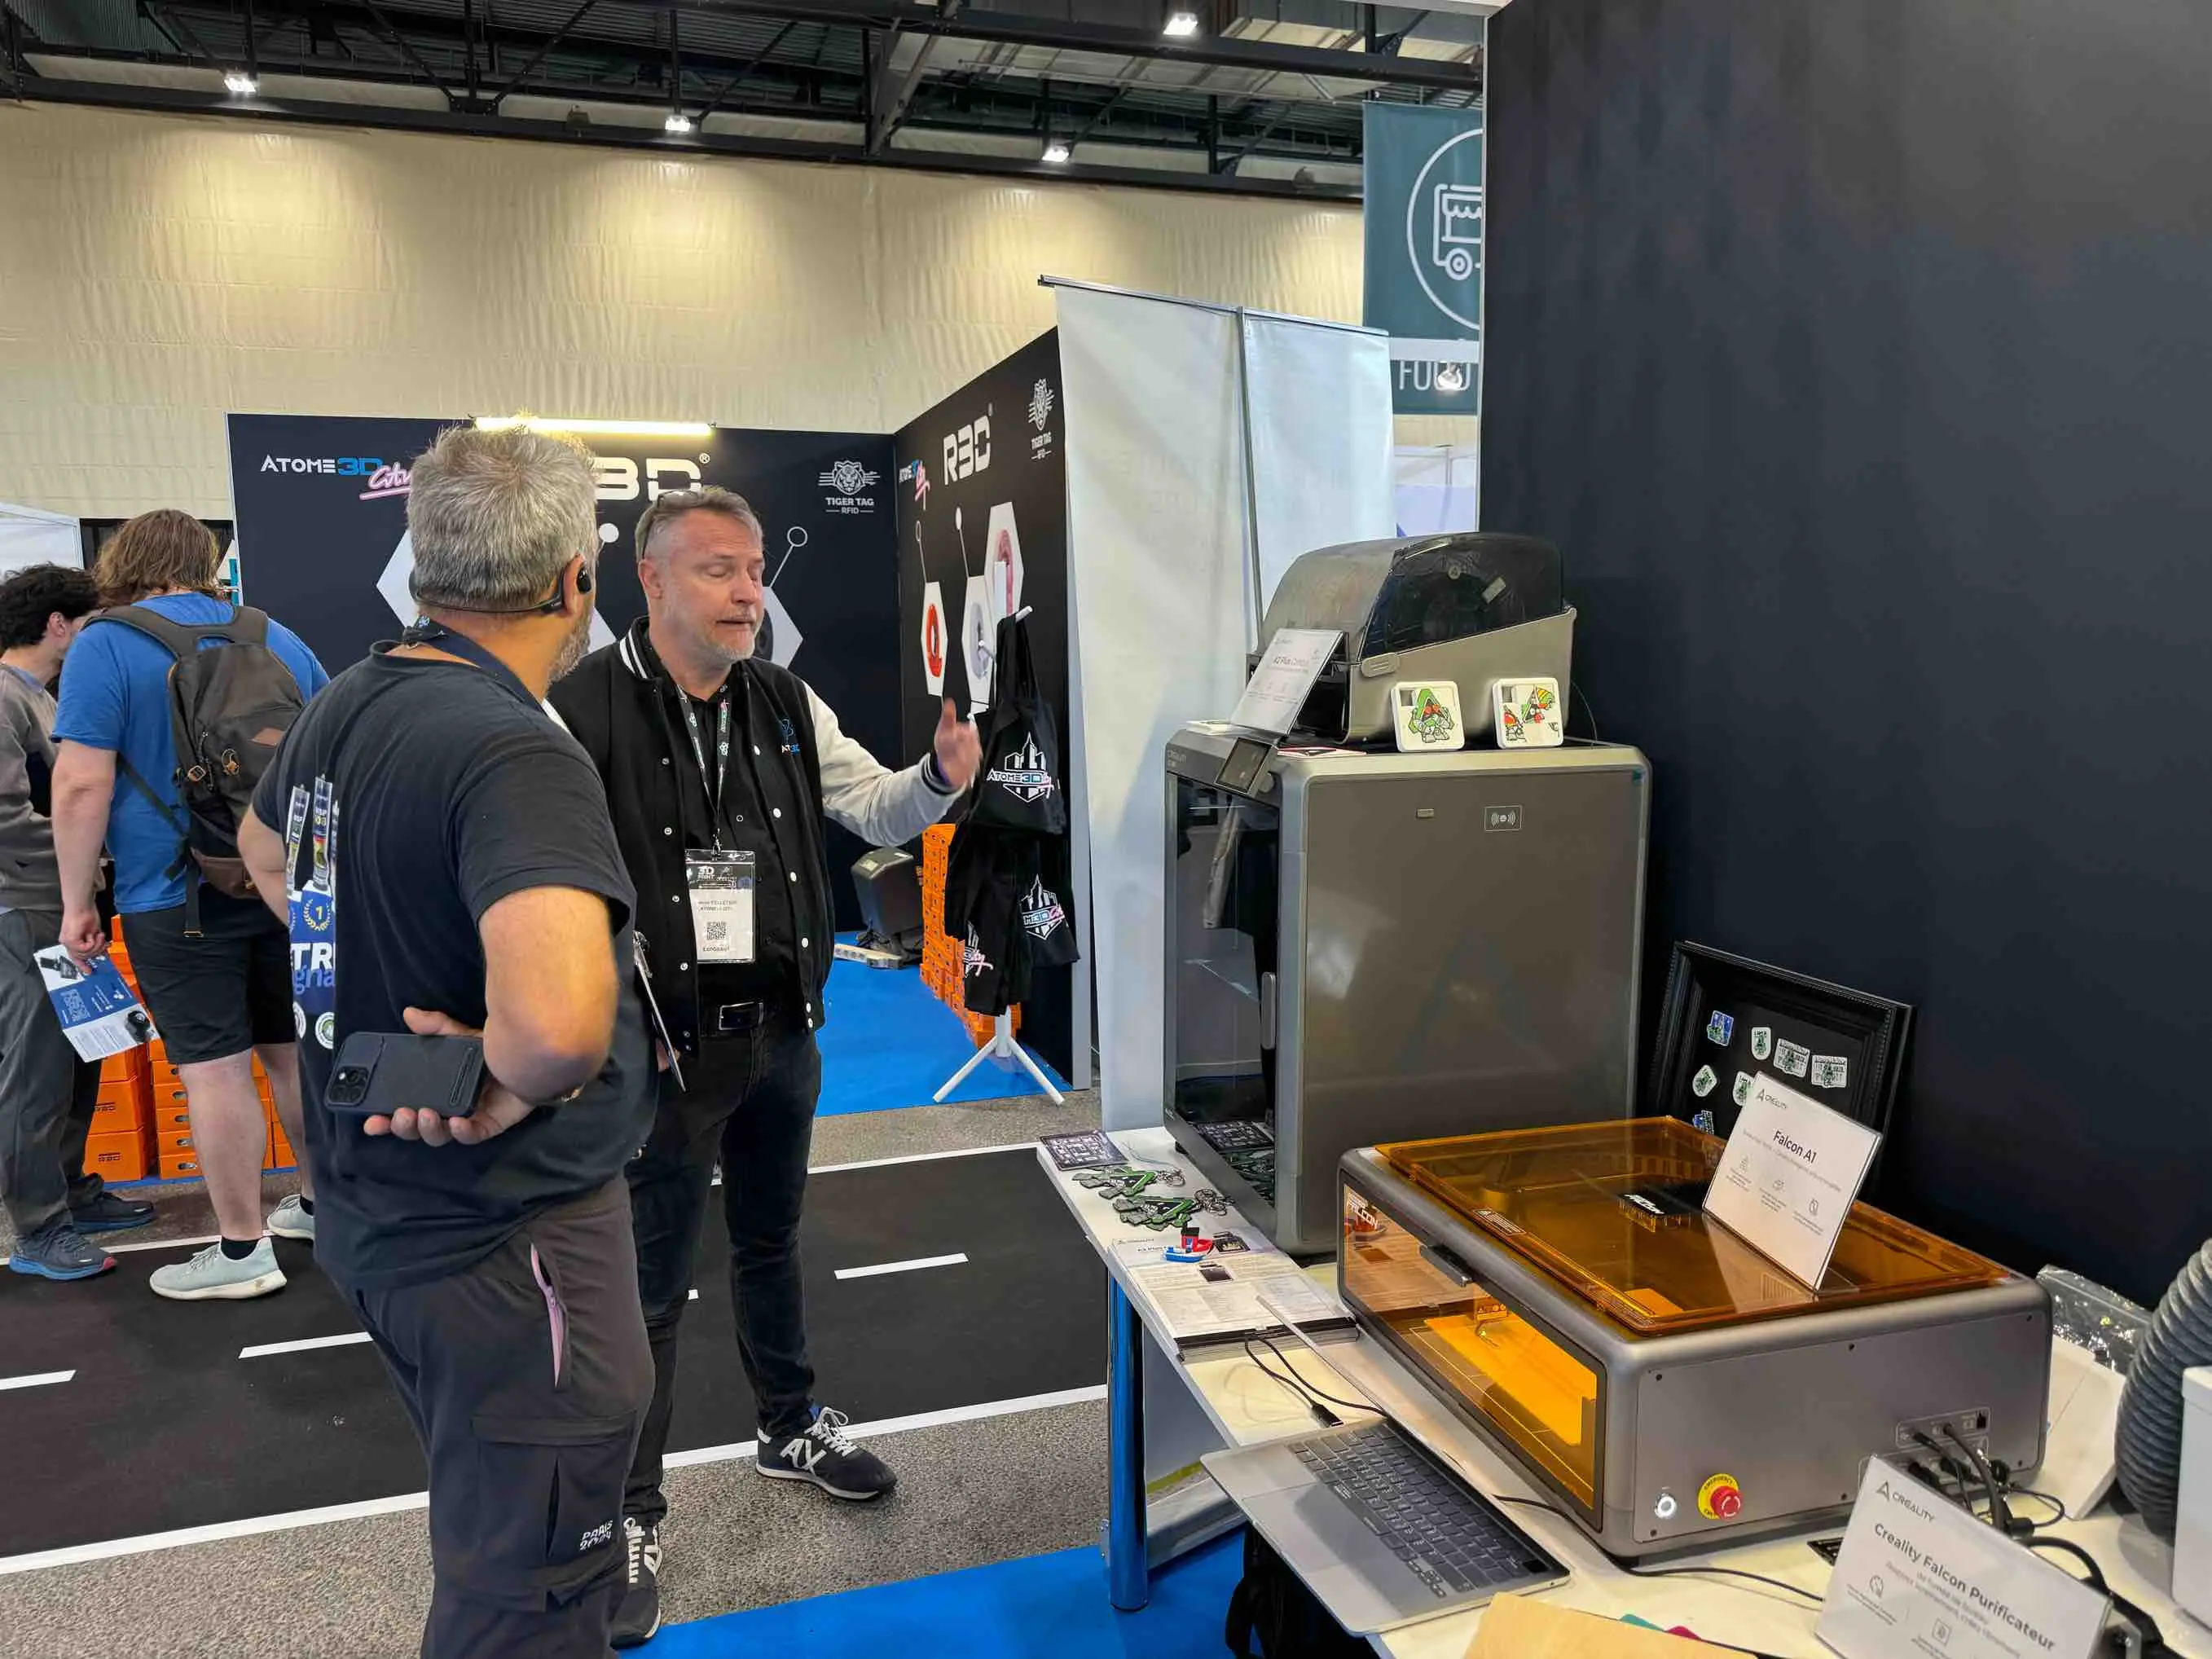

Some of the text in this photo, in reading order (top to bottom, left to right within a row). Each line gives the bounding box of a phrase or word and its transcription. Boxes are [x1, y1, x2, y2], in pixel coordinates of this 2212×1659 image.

[825, 497, 875, 507] TIGER TAG
[1774, 1130, 1817, 1164] Falcon A1
[1892, 1491, 1937, 1522] CREALITY
[1875, 1522, 1922, 1563] Creality
[1923, 1555, 1968, 1594] Falcon
[1969, 1586, 2056, 1652] Purificateur
